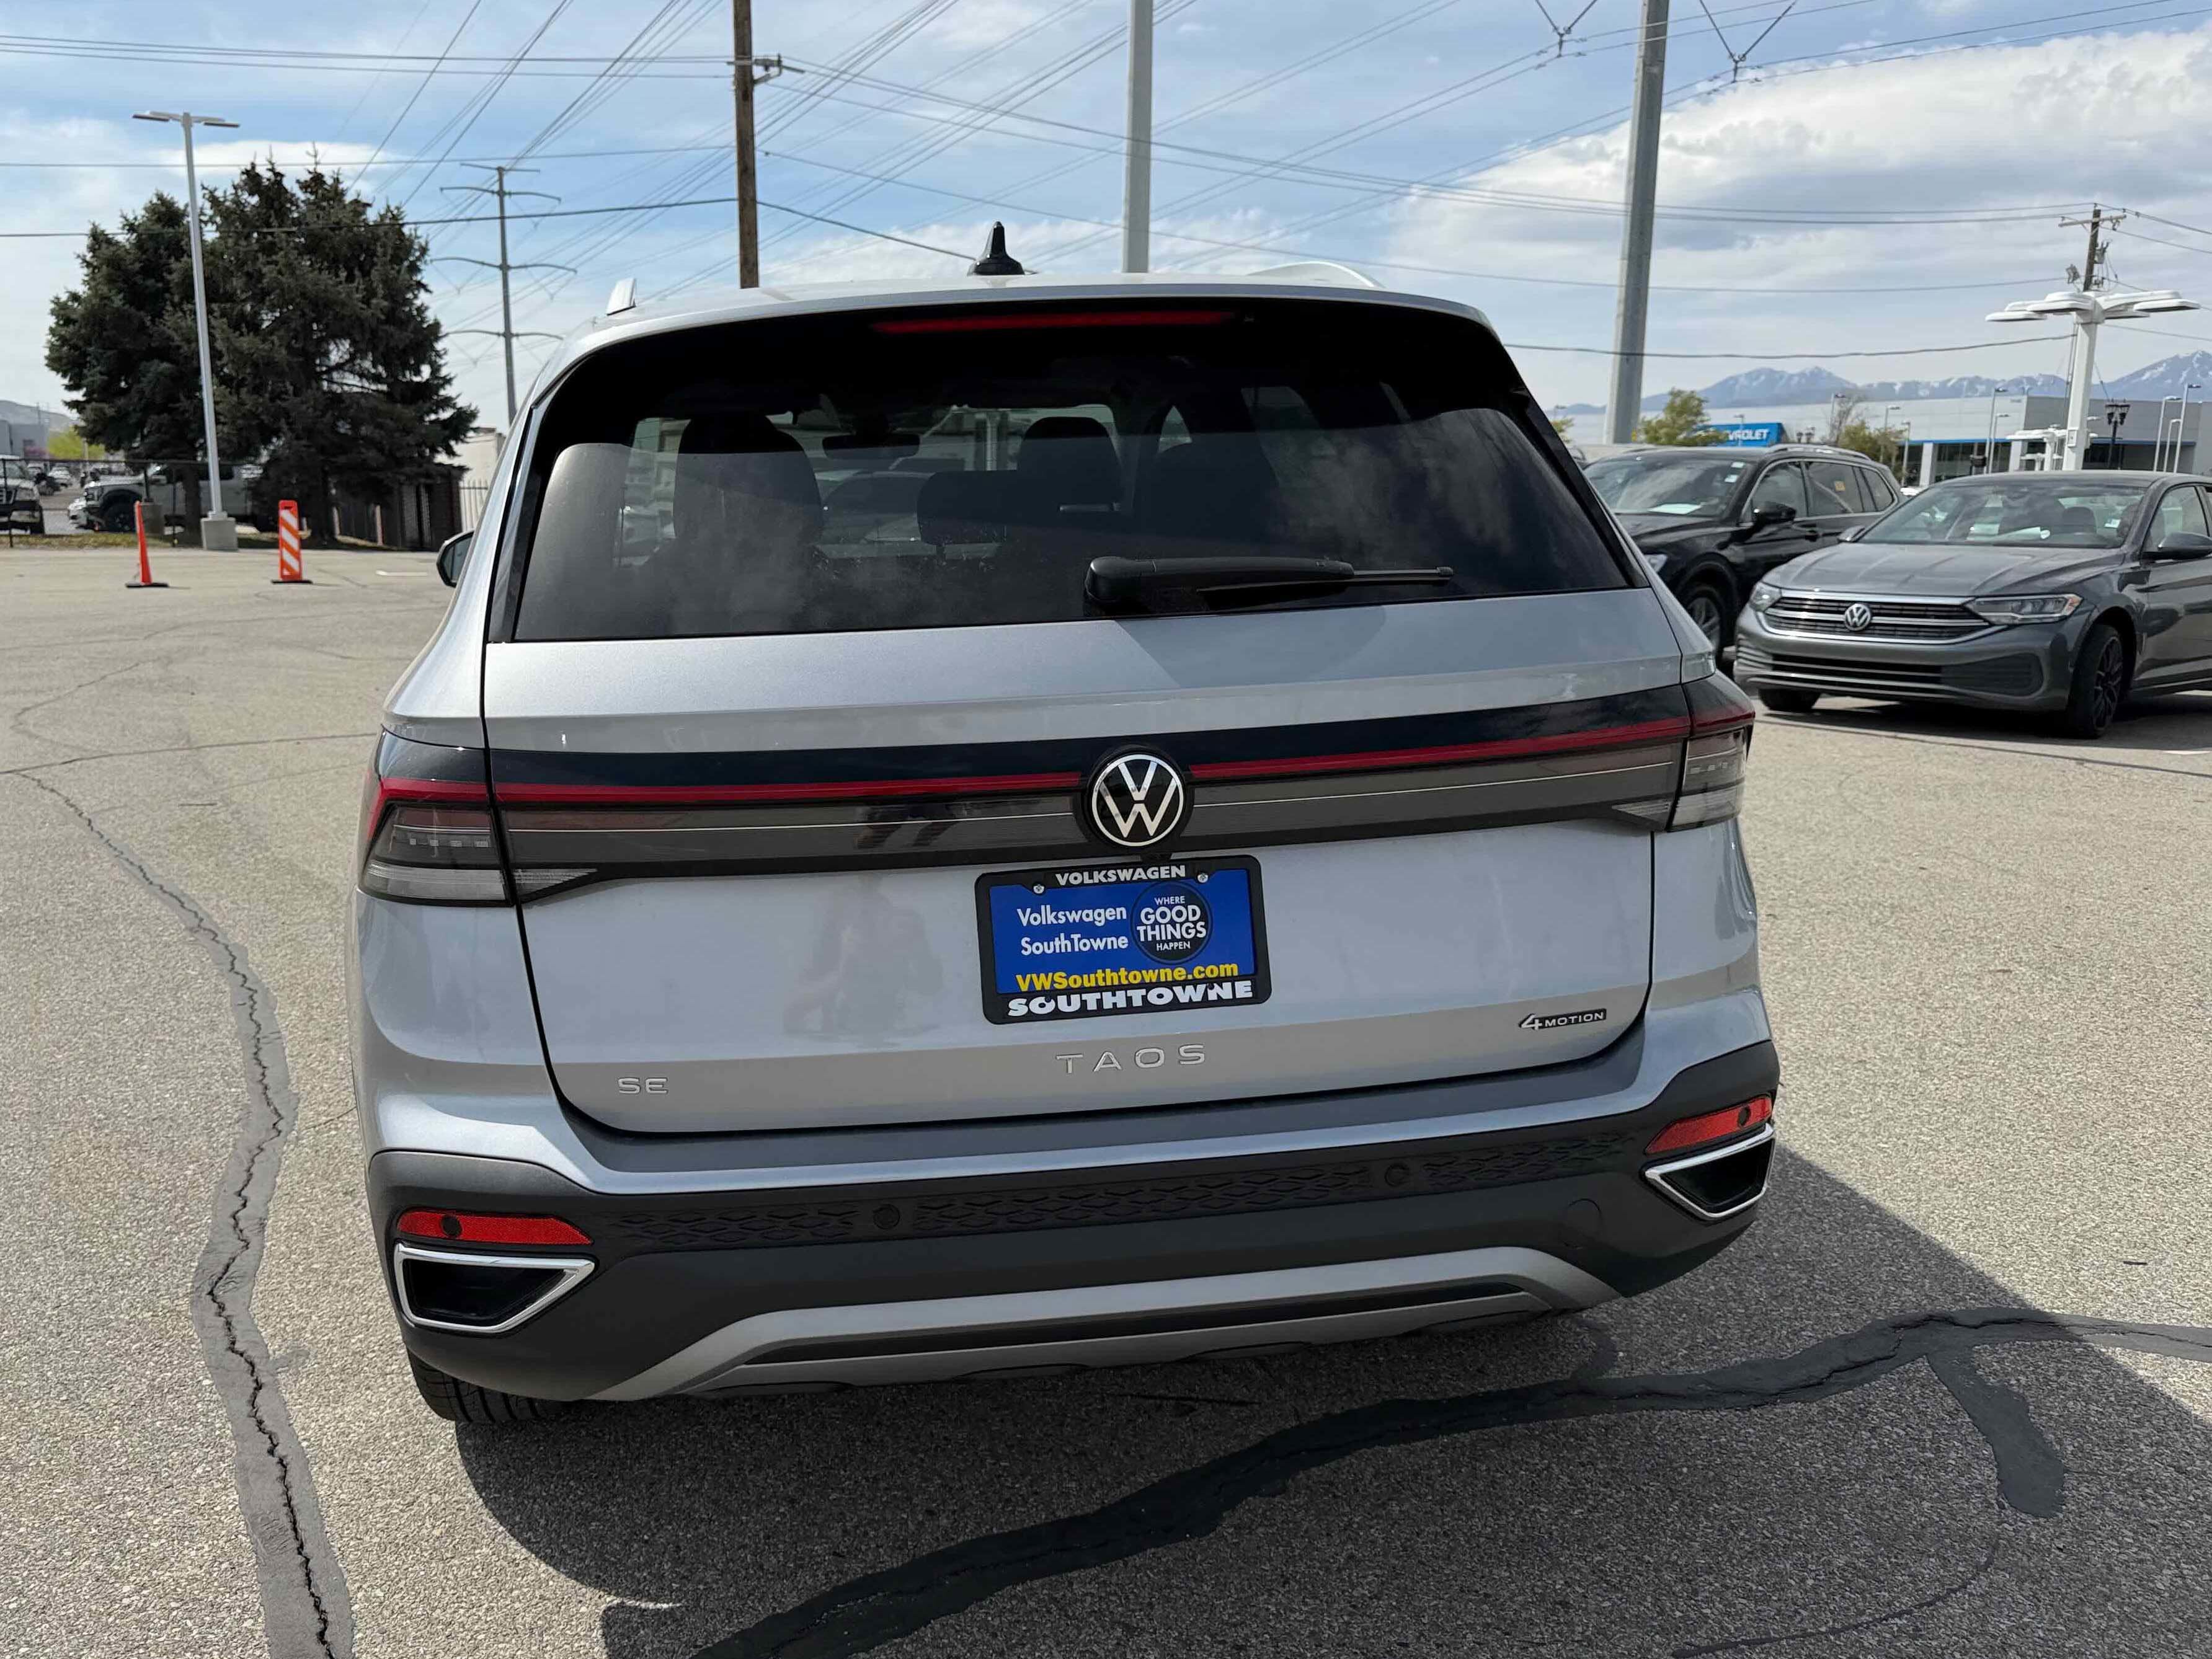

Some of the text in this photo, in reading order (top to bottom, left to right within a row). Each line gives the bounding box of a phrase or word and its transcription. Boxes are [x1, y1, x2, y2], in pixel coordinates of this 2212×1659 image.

[1095, 758, 1181, 843] VW
[1055, 865, 1186, 886] VOLKSWAGEN
[1154, 895, 1185, 905] WHERE
[1016, 905, 1127, 927] Volkswagen
[1140, 905, 1201, 924] GOOD
[1136, 921, 1207, 942] THINGS
[1020, 933, 1129, 956] SouthTowne
[1155, 940, 1191, 952] HAPPEN
[1015, 963, 1238, 992] VWSouthtowne.com
[1007, 980, 1253, 1017] SOUTHTOWNE
[1521, 1011, 1605, 1030] 4MOTION
[1055, 1043, 1206, 1074] TAOS
[618, 1077, 668, 1094] SE
